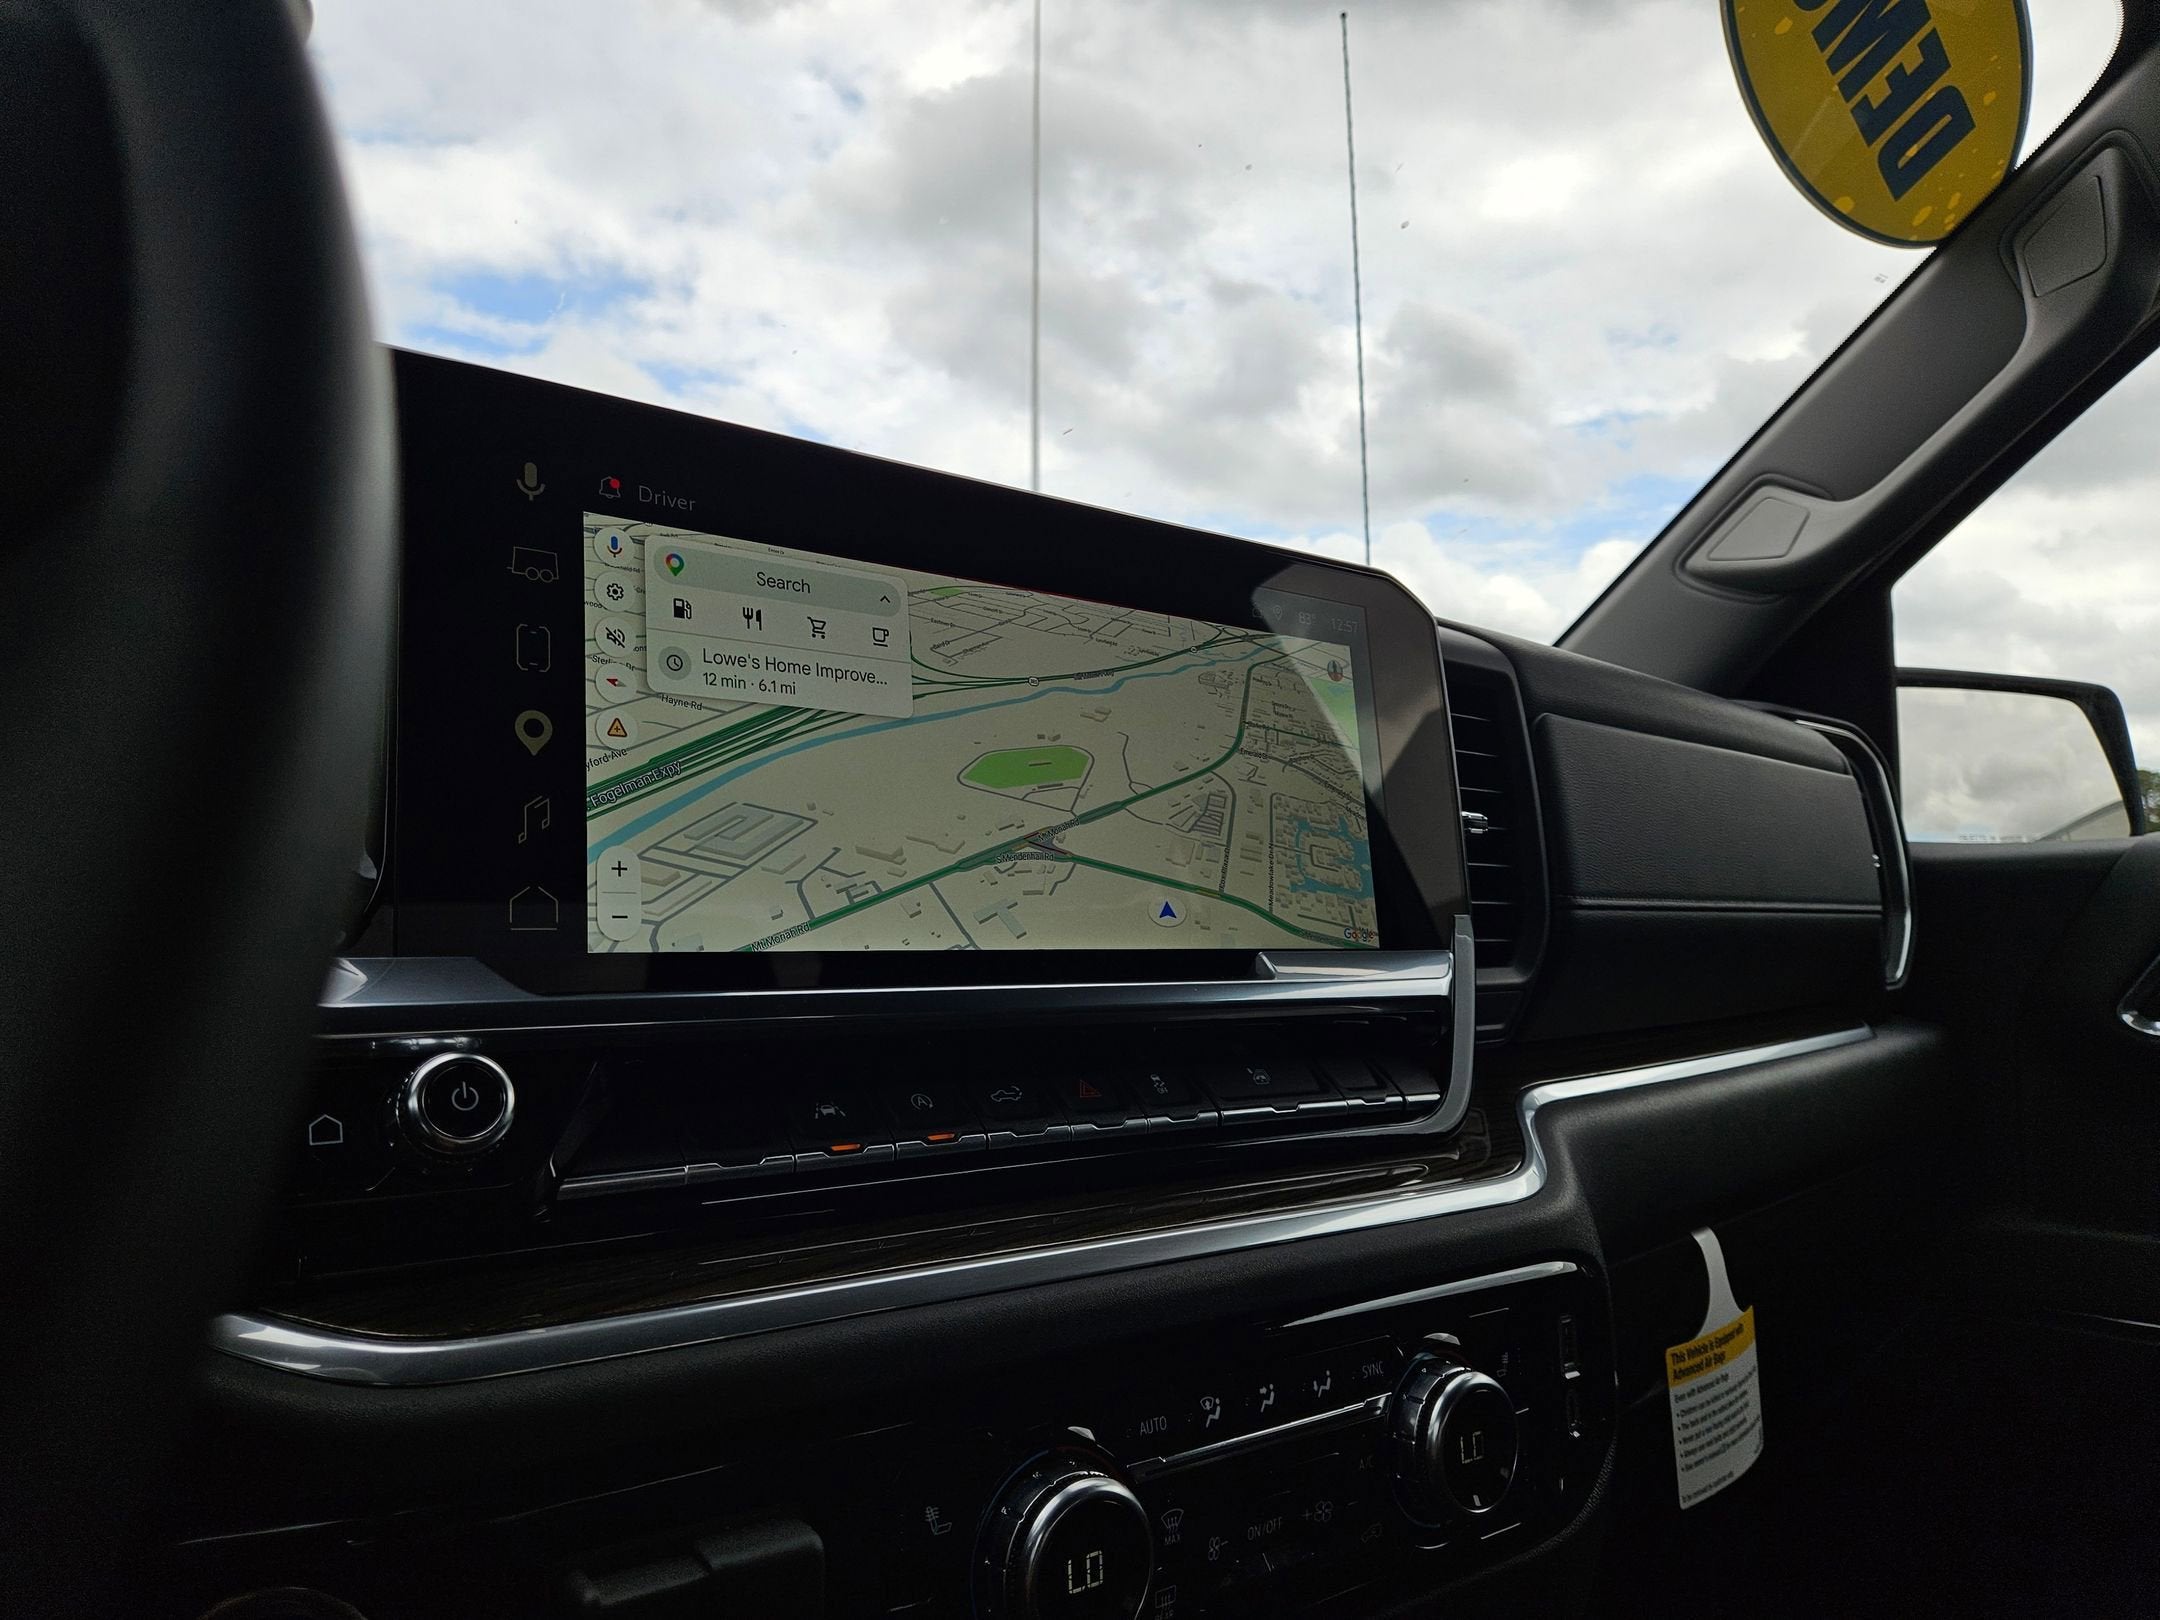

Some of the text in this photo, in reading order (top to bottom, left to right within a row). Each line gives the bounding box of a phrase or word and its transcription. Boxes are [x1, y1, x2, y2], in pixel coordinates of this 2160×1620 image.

[638, 485, 696, 512] Driver
[756, 571, 812, 595] Search
[1331, 617, 1359, 633] 12:57
[703, 648, 889, 687] Lowe's Home Improve...
[703, 672, 796, 696] 12 min 6.1 mi
[661, 694, 703, 711] Hayne Rd
[610, 748, 628, 761] Ave
[590, 760, 683, 807] Fogelman Expy
[1044, 852, 1054, 861] Rd
[797, 922, 810, 934] Rd
[1672, 1350, 1686, 1366] This
[1361, 1361, 1384, 1379] SYNC
[1139, 1416, 1168, 1436] AUTO
[1246, 1517, 1283, 1541] ON/OFF
[1164, 1533, 1182, 1545] MAX
